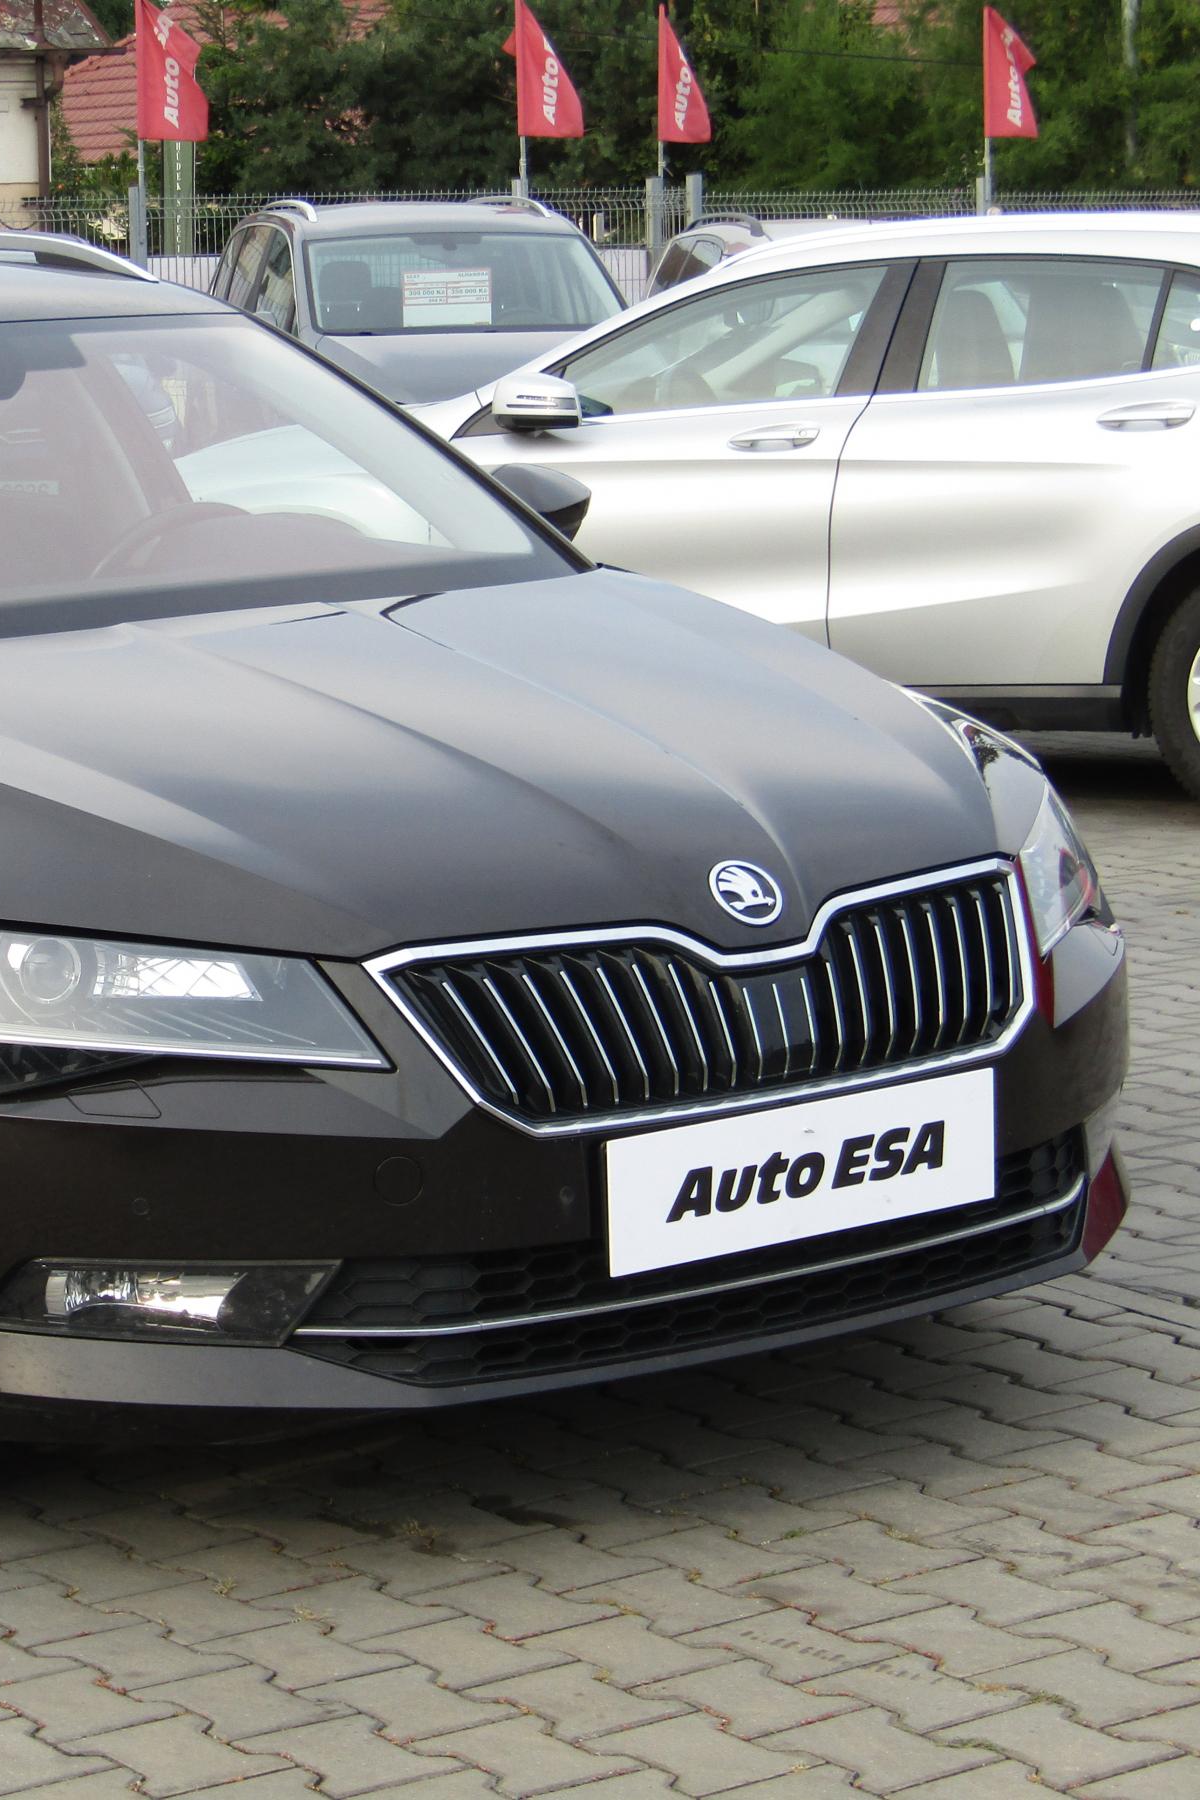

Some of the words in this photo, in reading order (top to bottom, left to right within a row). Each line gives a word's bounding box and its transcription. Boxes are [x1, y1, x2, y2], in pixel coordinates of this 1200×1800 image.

[163, 57, 180, 129] Auto
[541, 56, 559, 126] Auto
[674, 66, 691, 131] Auto
[666, 1151, 825, 1223] Auto
[831, 1120, 945, 1190] ESA
